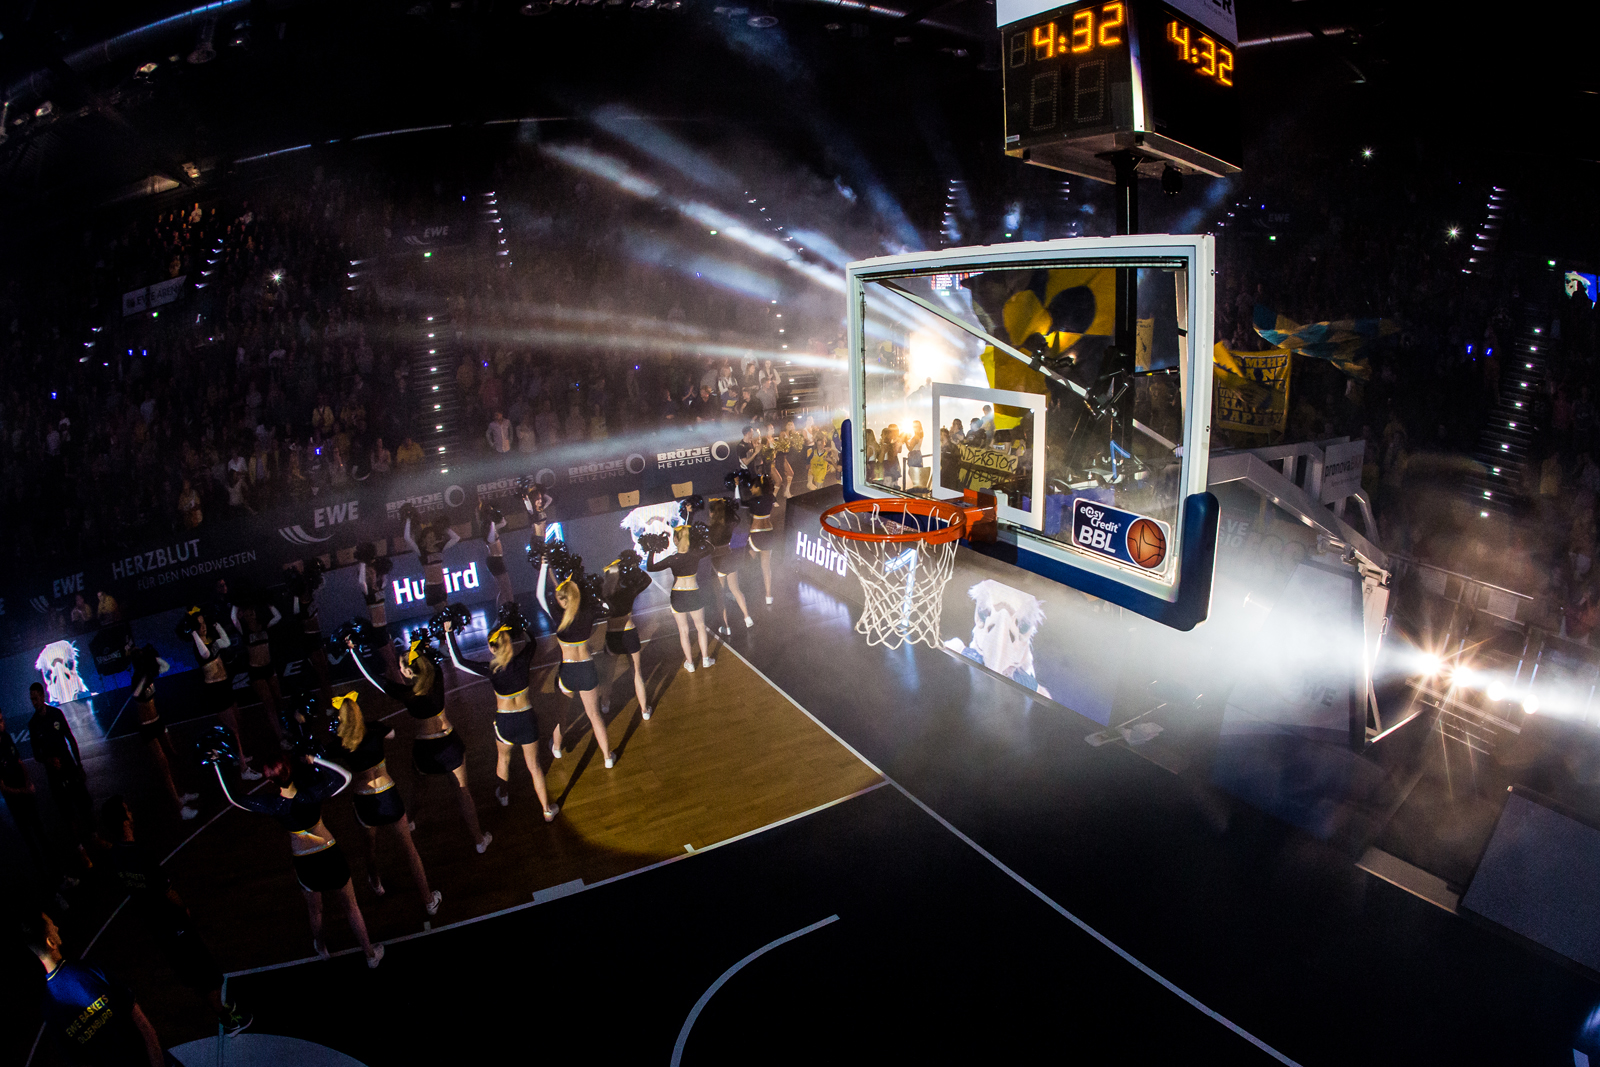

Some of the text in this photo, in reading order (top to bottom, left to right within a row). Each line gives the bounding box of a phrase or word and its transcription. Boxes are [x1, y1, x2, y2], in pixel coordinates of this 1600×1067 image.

[1033, 3, 1124, 58] 4:32
[1167, 20, 1234, 87] 4:32
[424, 226, 449, 239] EWE
[1268, 213, 1290, 223] EWE
[568, 459, 625, 476] BRÖTJE
[657, 446, 710, 461] BRÖTJE
[658, 456, 711, 470] HEIZUNG
[569, 470, 625, 484] HEIZUNG
[314, 500, 359, 529] EWE
[796, 531, 850, 577] Hubird
[1079, 525, 1116, 554] BBL
[111, 538, 200, 580] HERZBLUT
[137, 550, 257, 591] FÜR DEN NORDWESTEN
[53, 571, 85, 599] EWE
[393, 562, 480, 605] Huird
[65, 994, 110, 1038] EWE BASKETS
[77, 1008, 114, 1045] OLDENBURG
